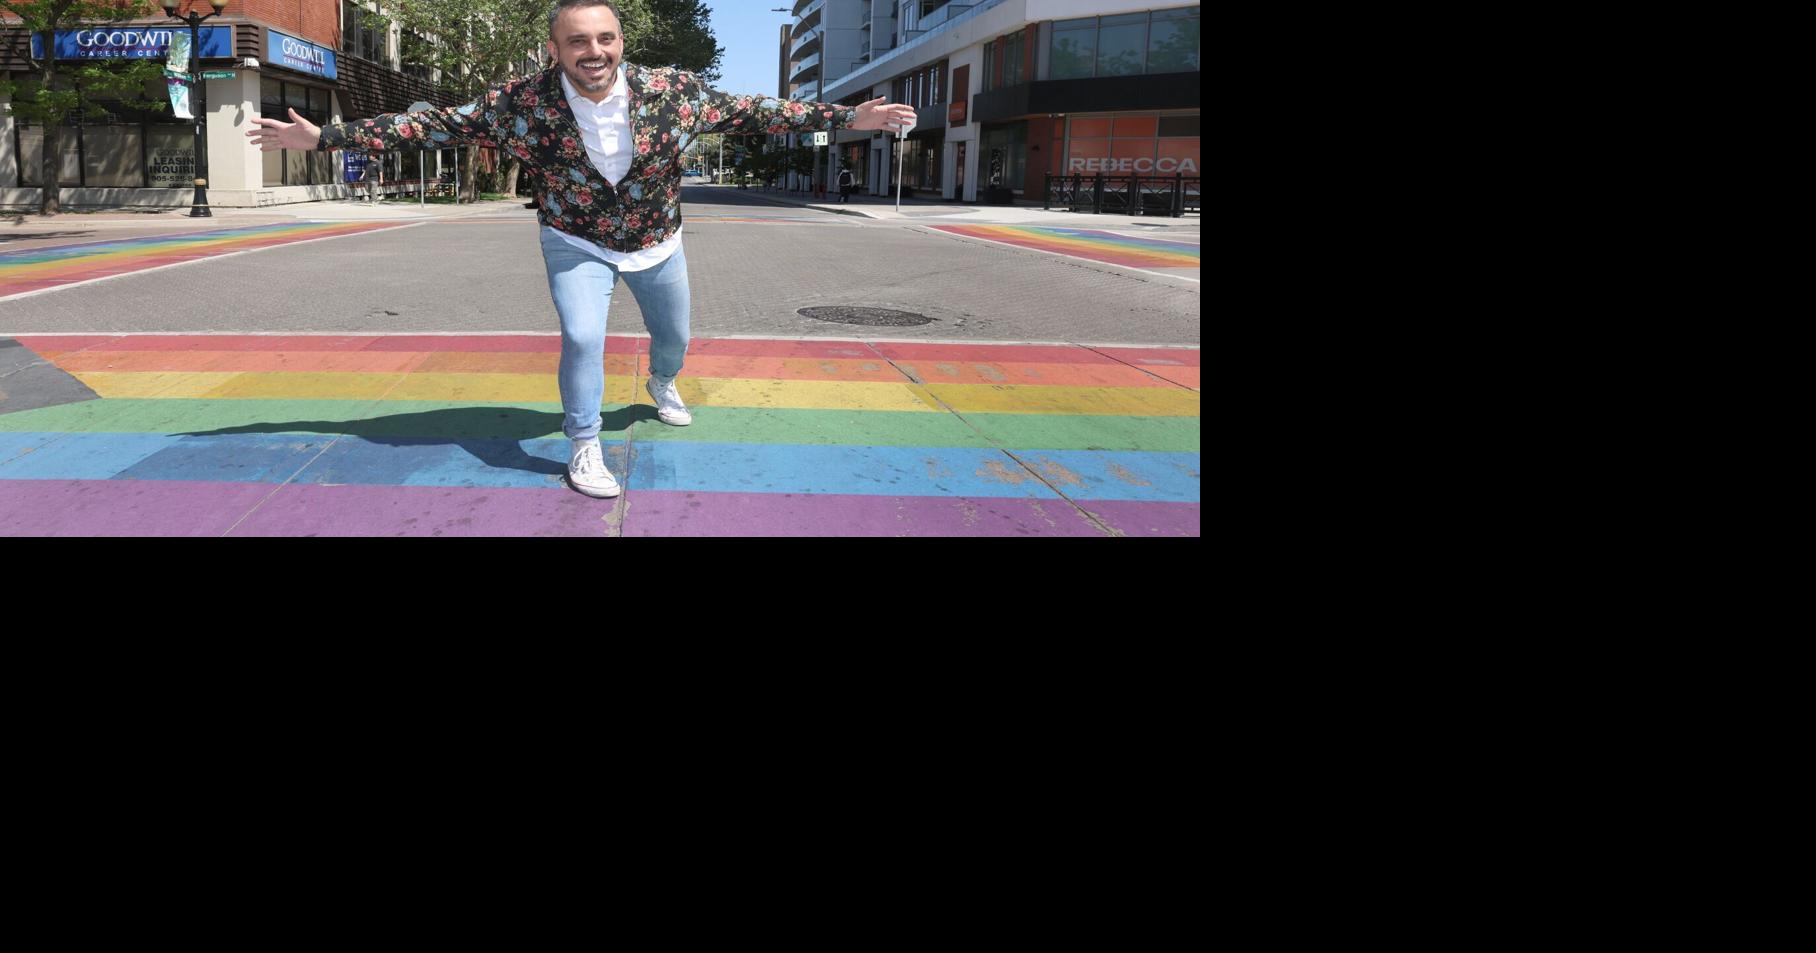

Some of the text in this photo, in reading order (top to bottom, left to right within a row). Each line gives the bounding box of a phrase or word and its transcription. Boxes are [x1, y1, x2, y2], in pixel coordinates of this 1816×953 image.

[154, 157, 194, 165] LEASIN
[1069, 157, 1197, 173] REBECCA
[149, 166, 194, 174] INQUIRI
